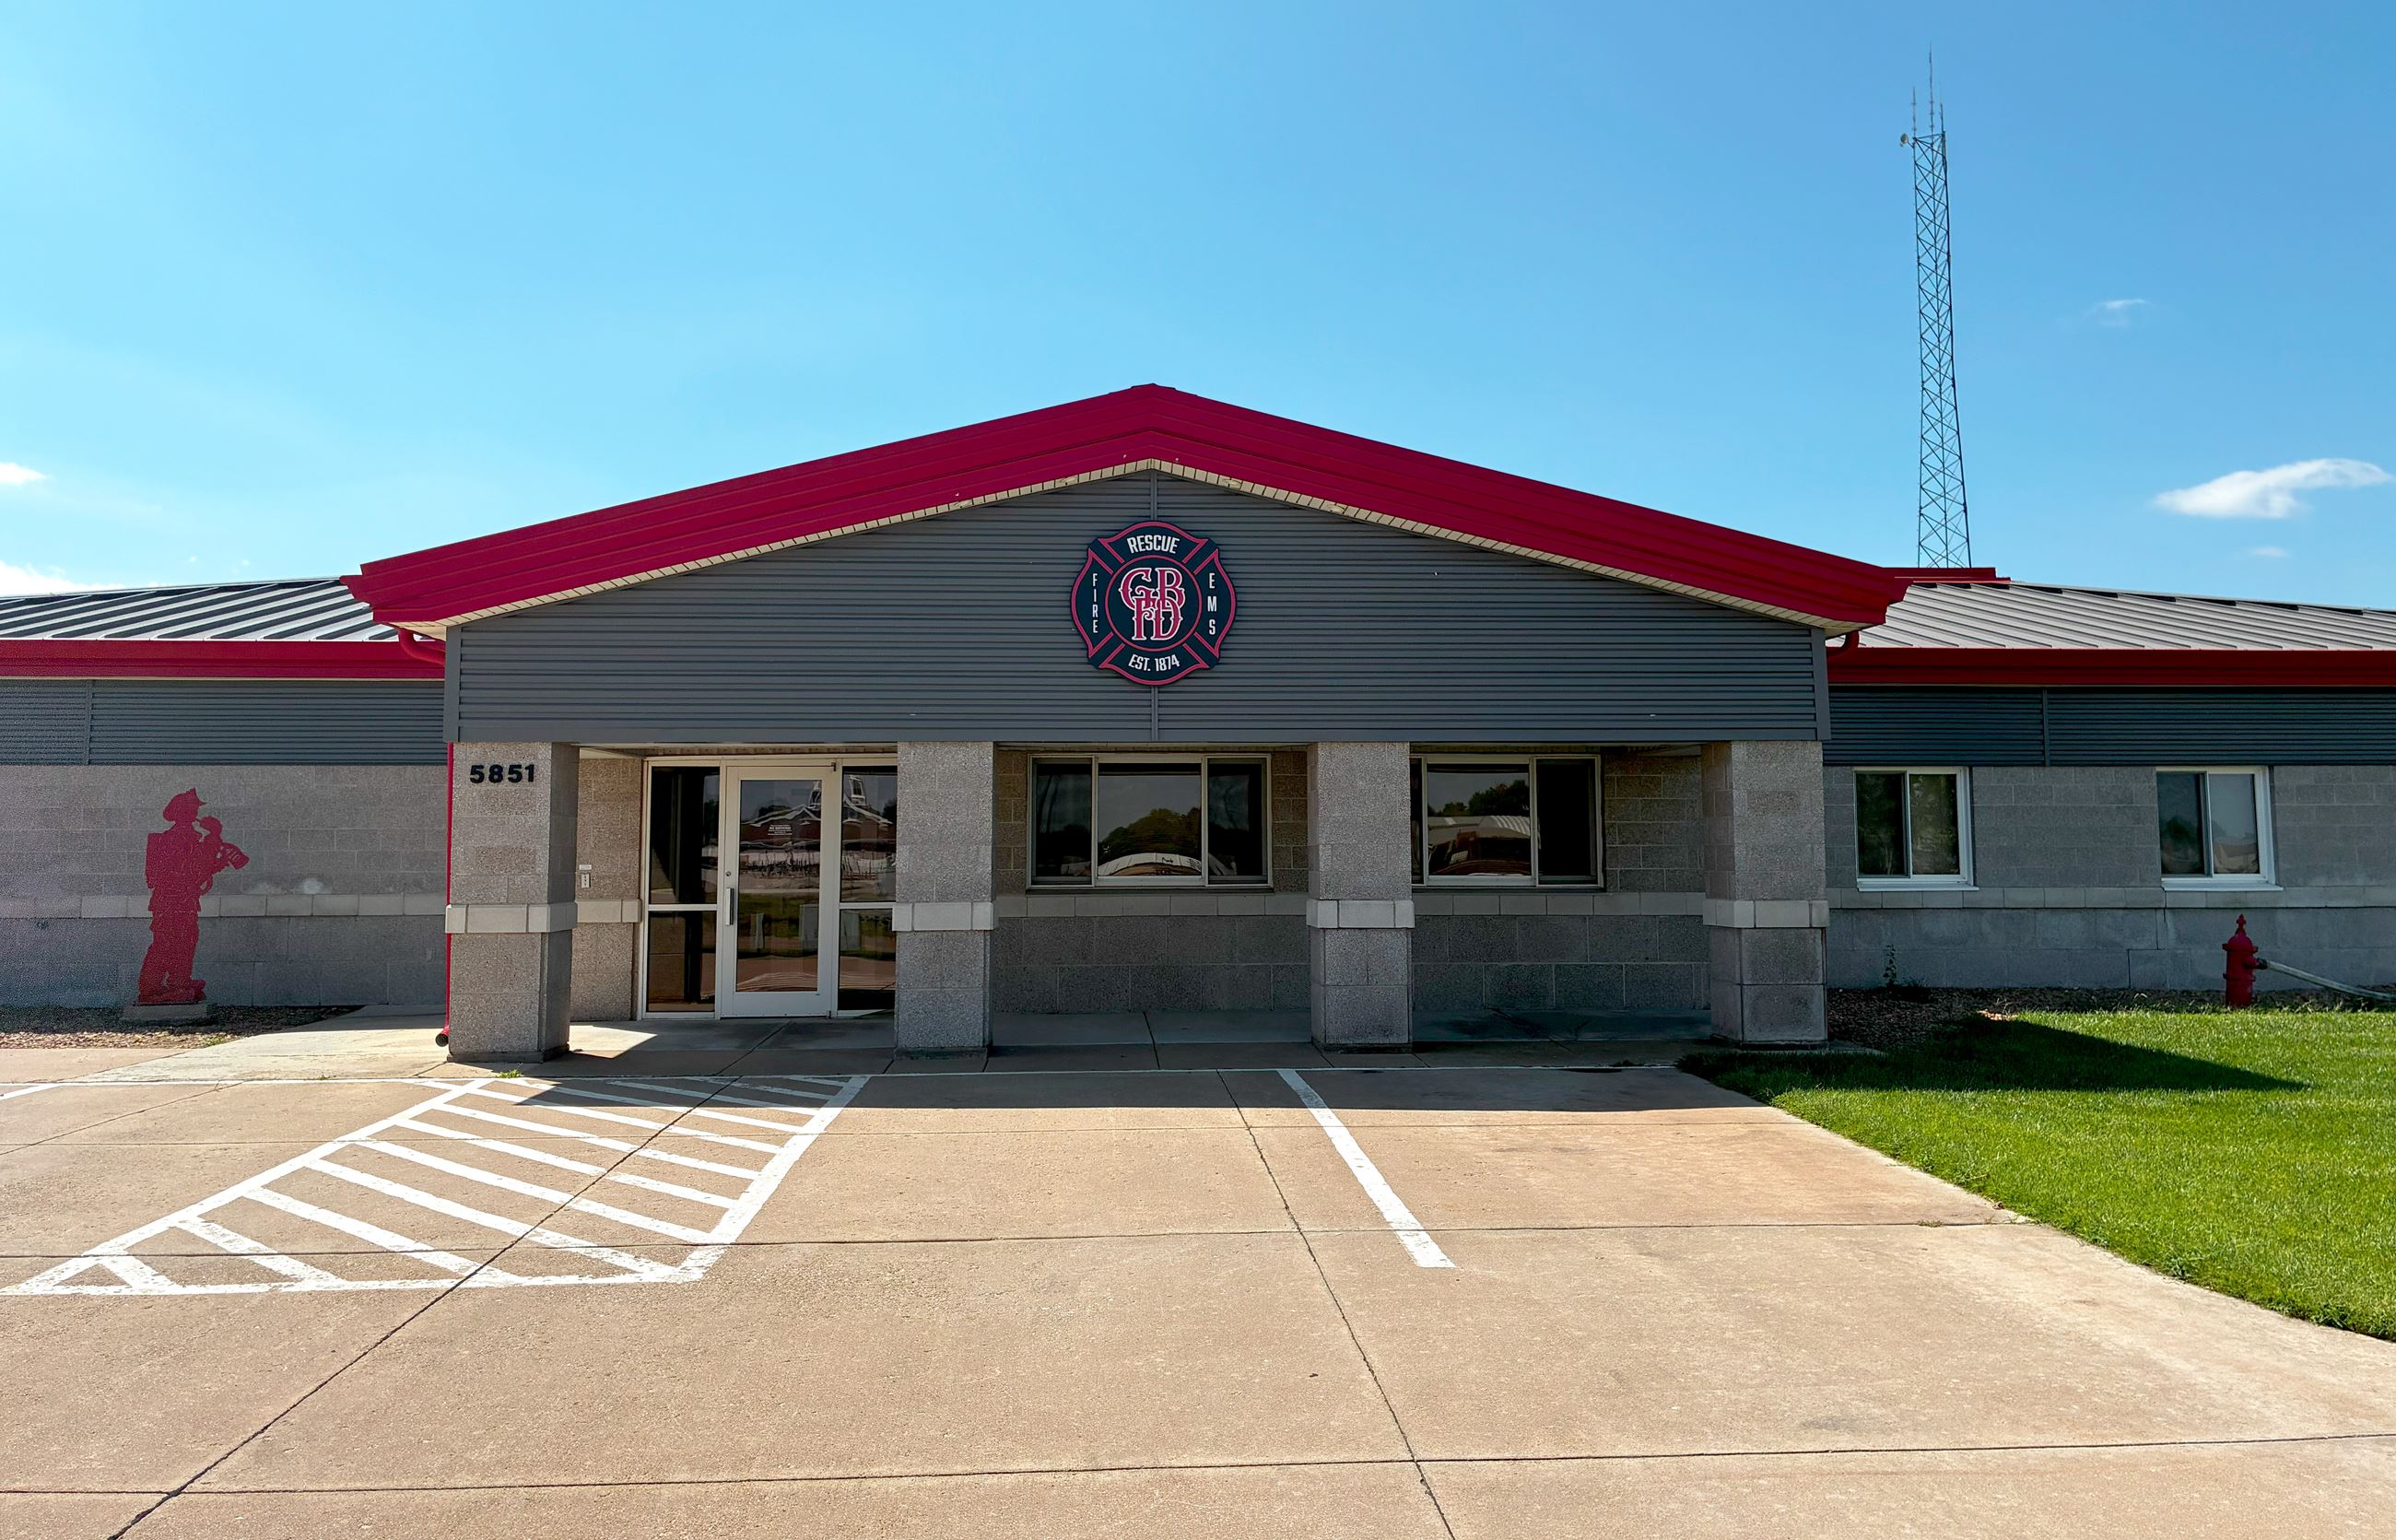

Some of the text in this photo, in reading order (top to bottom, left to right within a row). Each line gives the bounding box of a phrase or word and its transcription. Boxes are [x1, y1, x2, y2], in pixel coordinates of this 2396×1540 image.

[1126, 535, 1180, 554] RESCUE
[1207, 572, 1217, 636] EMS
[1128, 653, 1180, 672] EST. 1874
[469, 764, 534, 783] 5851
